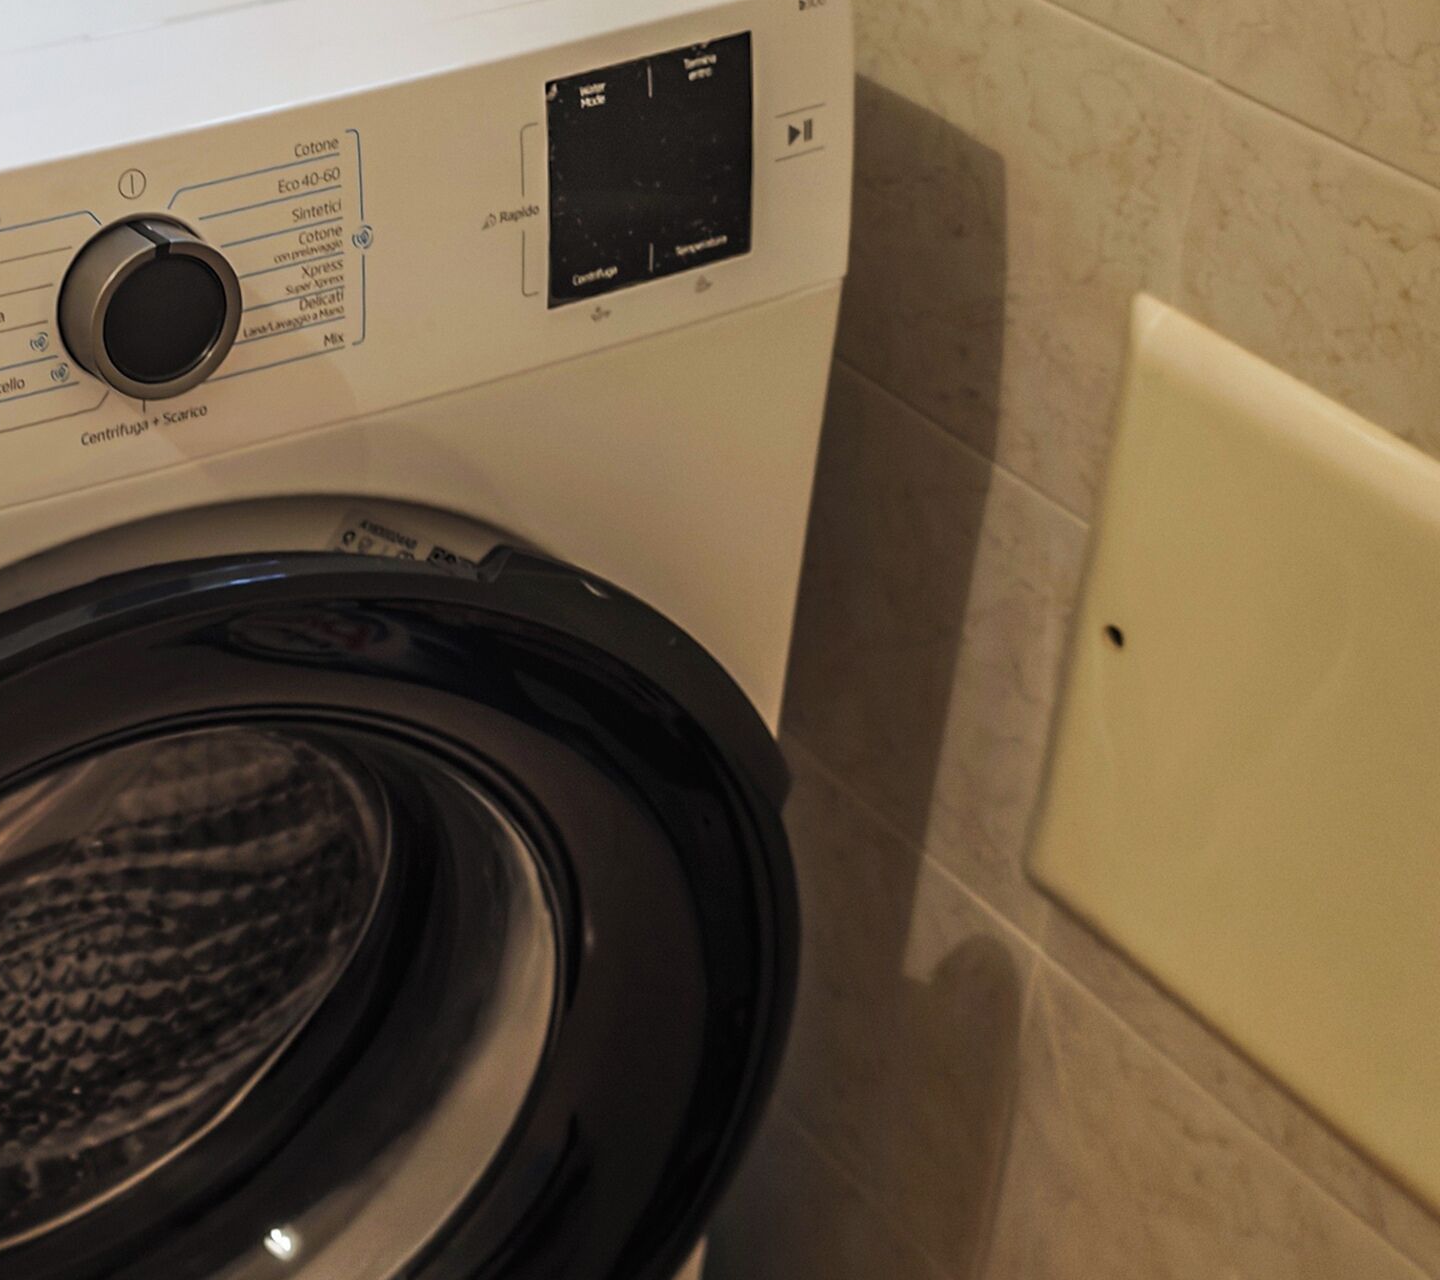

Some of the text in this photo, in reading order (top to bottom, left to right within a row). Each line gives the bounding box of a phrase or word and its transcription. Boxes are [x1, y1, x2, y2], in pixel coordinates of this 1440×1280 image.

[293, 137, 340, 159] Cotone
[277, 166, 341, 195] Eco 40-60
[291, 198, 343, 223] Sintetici
[499, 203, 541, 224] Rapido
[298, 225, 343, 246] Cotone
[300, 259, 344, 280] Xpress
[299, 289, 345, 312] Delicati
[323, 332, 345, 347] Mix
[80, 419, 150, 447] Centrifuga
[162, 404, 209, 425] Scarico
